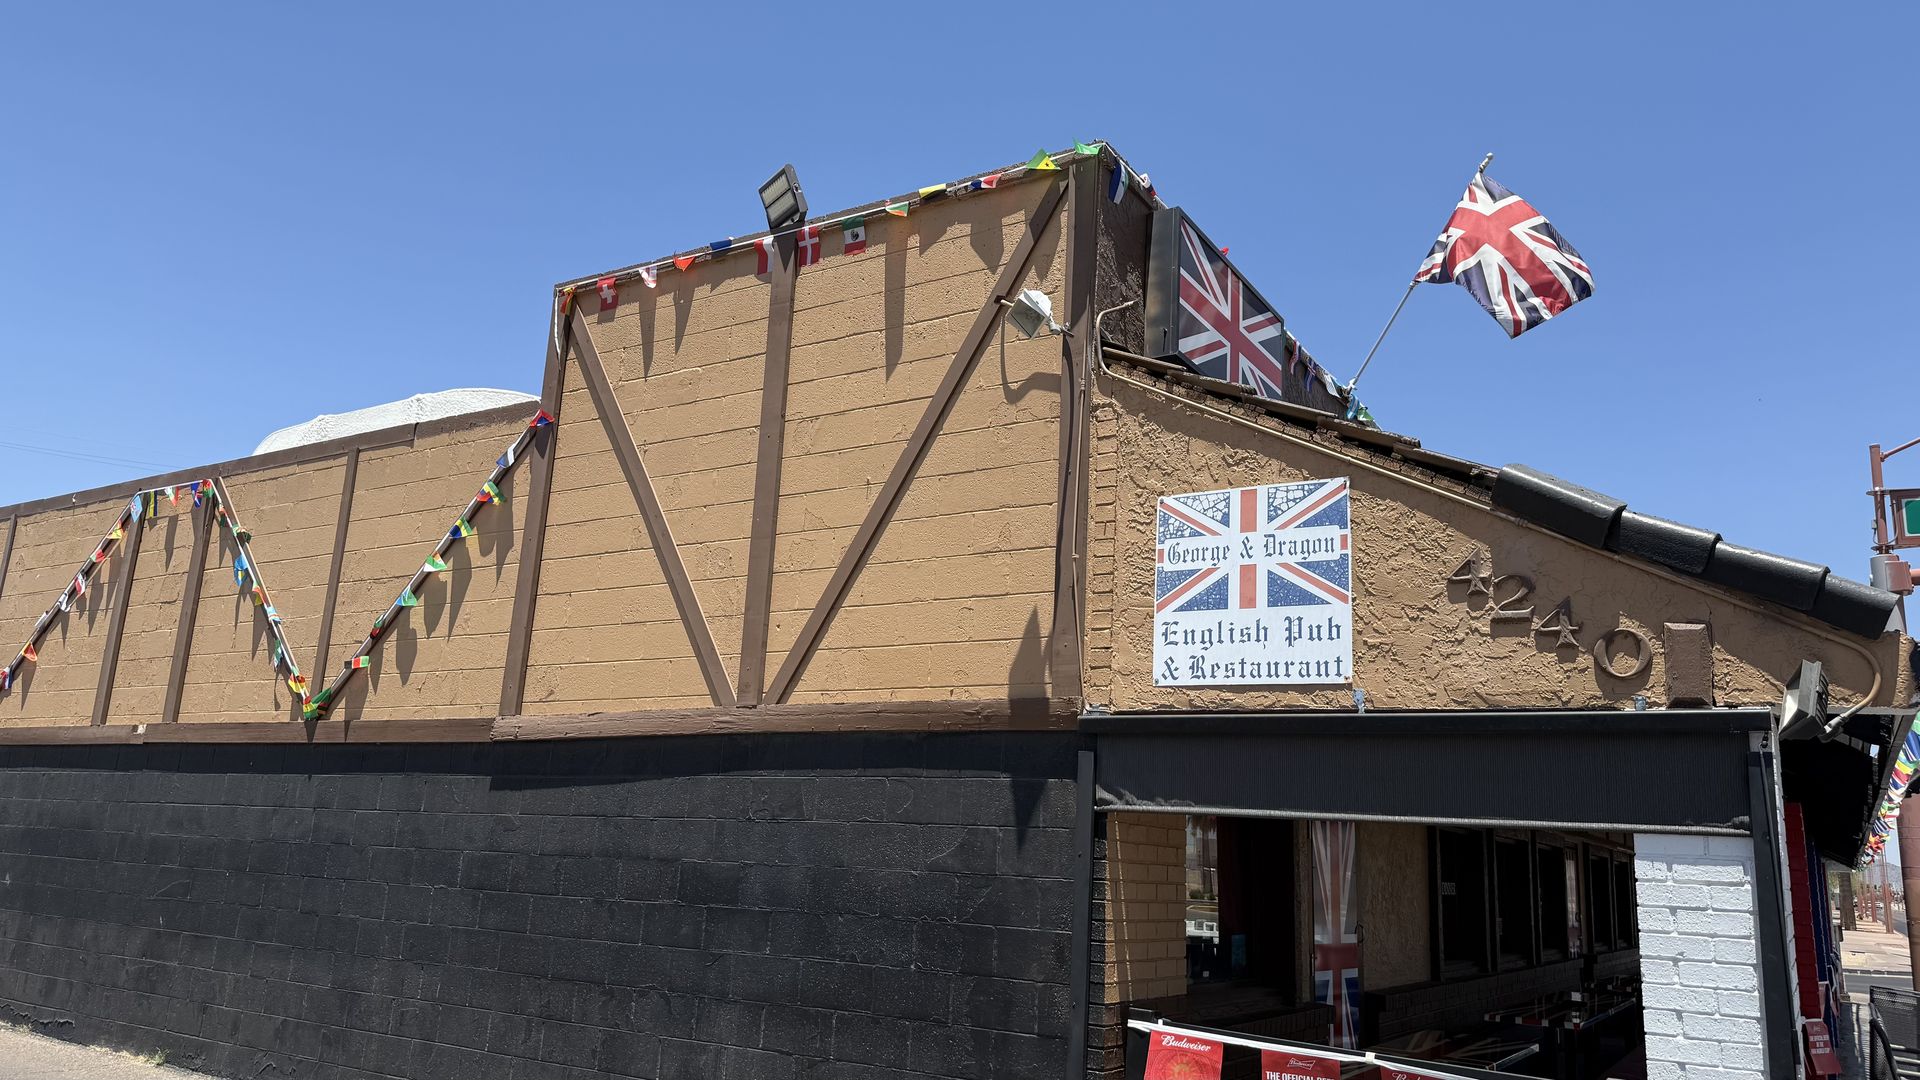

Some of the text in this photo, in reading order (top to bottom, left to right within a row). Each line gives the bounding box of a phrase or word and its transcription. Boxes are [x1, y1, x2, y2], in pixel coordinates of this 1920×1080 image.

[1167, 533, 1335, 567] George & Dragon
[1446, 547, 1653, 678] 4240
[1161, 615, 1342, 651] English Pub
[1161, 654, 1345, 681] & Restaurant
[1161, 1034, 1211, 1052] Budweiser
[1265, 1071, 1281, 1080] THE
